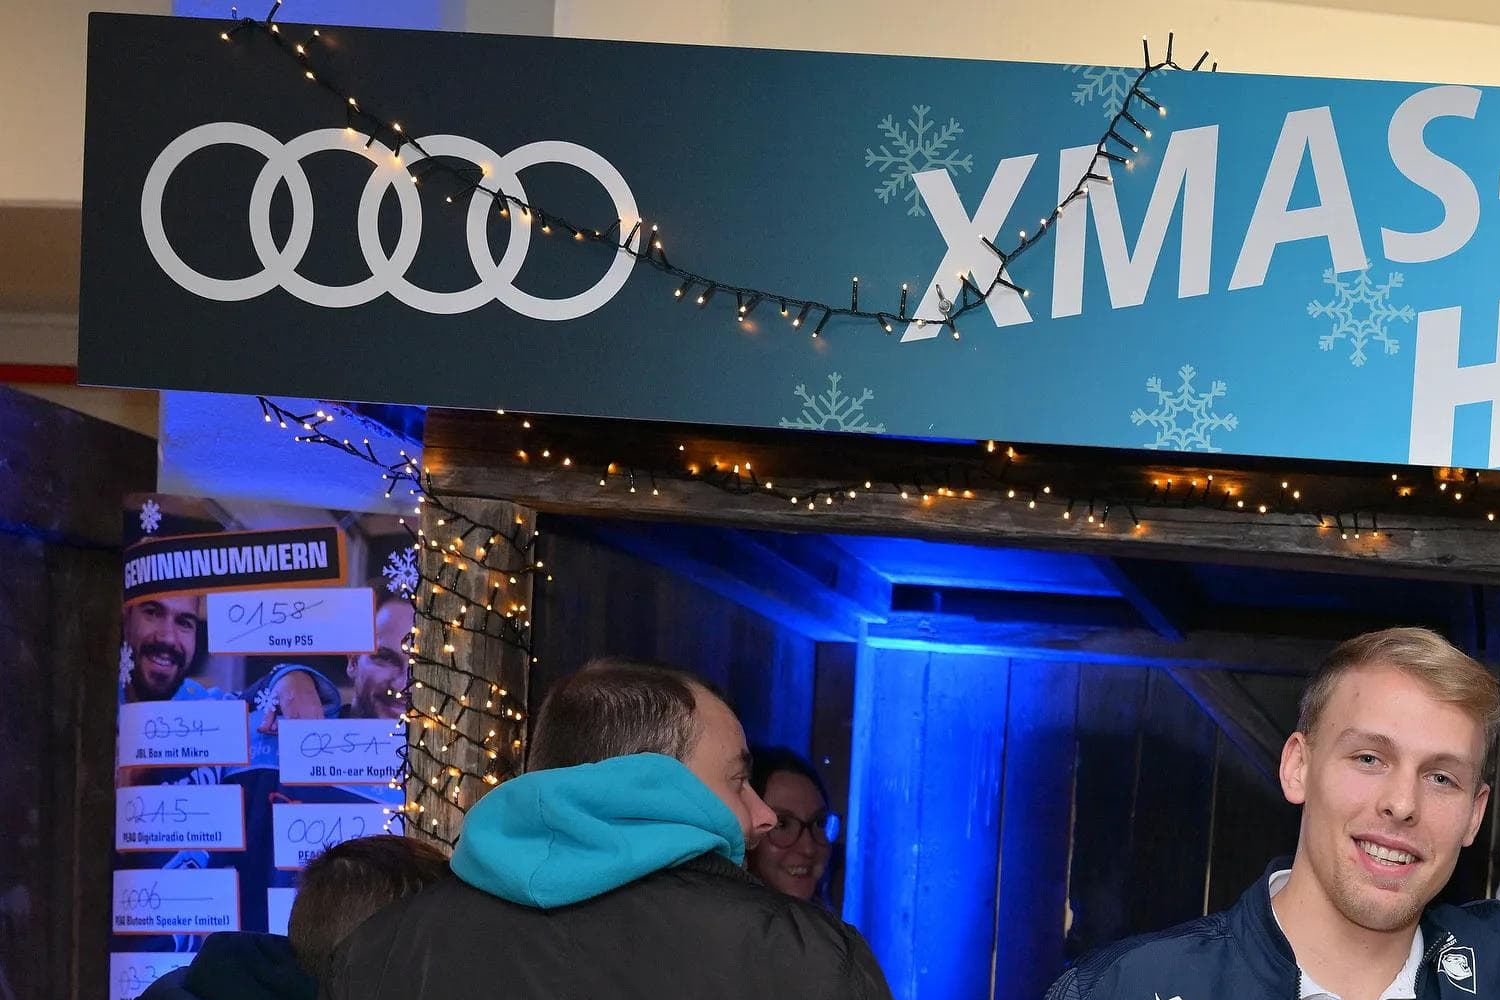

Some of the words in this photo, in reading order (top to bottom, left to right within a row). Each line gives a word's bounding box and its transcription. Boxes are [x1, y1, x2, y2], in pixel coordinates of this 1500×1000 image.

[124, 540, 329, 590] GEWINNNUMMERN
[228, 600, 306, 626] 0158
[268, 635, 292, 649] Sony
[295, 635, 314, 647] PS5
[165, 747, 179, 758] mit
[181, 747, 209, 759] Mikro
[310, 766, 327, 777] JBL
[329, 766, 364, 777] On-ear
[187, 831, 222, 843] (mittel)
[156, 914, 192, 928] Speaker
[195, 914, 230, 927] (mittel)
